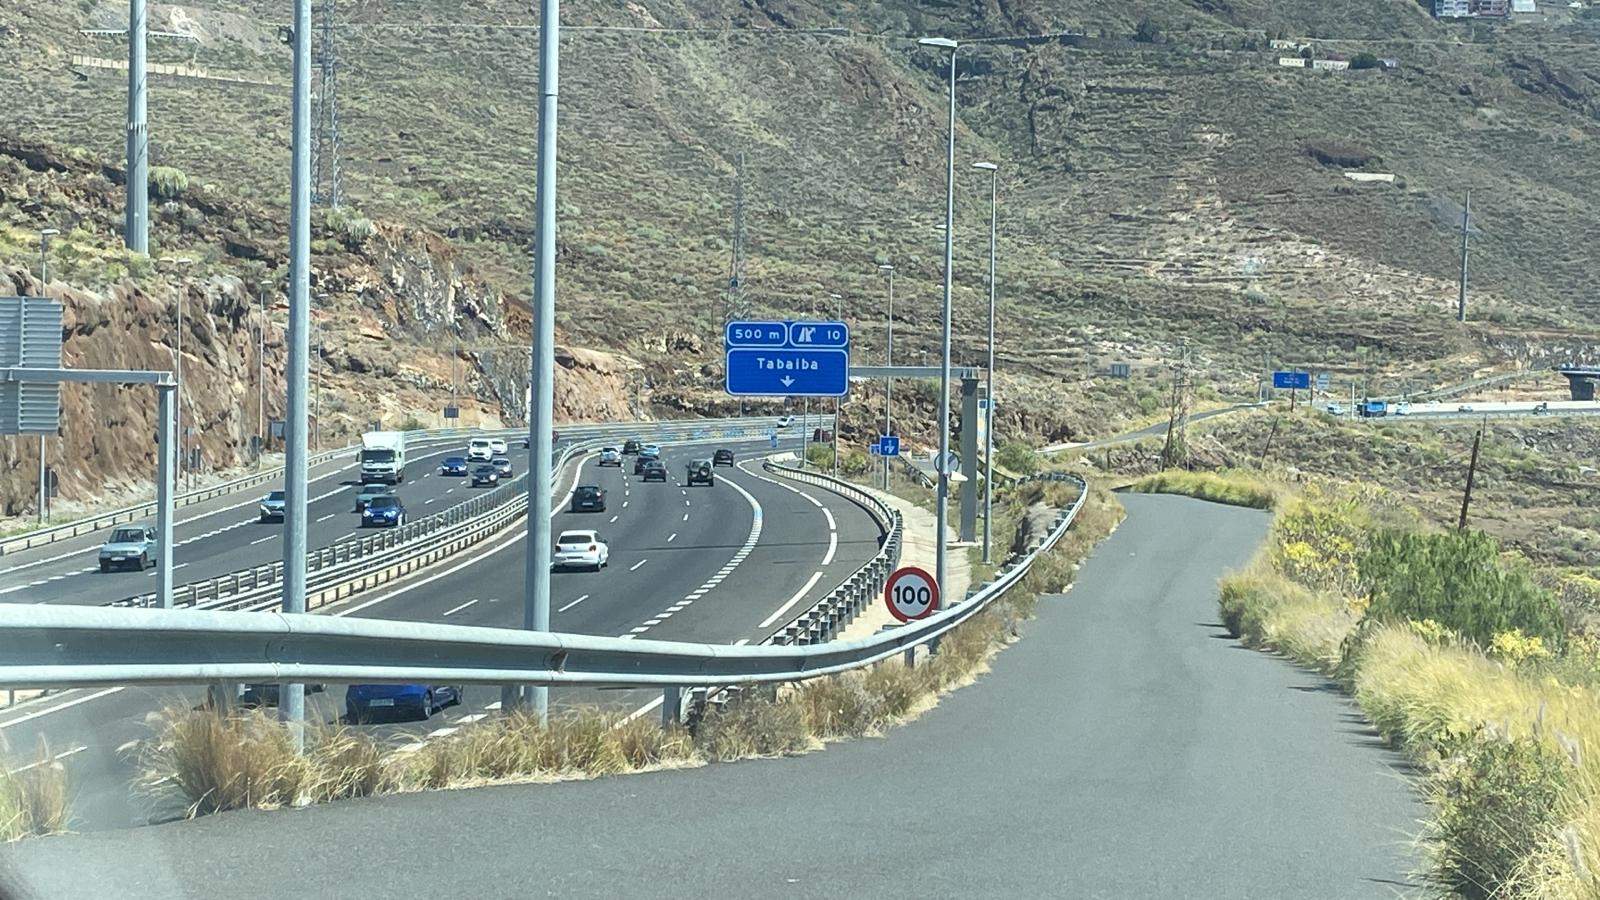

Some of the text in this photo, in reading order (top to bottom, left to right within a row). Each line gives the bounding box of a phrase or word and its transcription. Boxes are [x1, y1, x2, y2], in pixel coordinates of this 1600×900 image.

[735, 329, 780, 339] 500 m
[827, 330, 841, 340] 10
[757, 358, 818, 370] Tabaiba
[894, 585, 931, 606] 100
